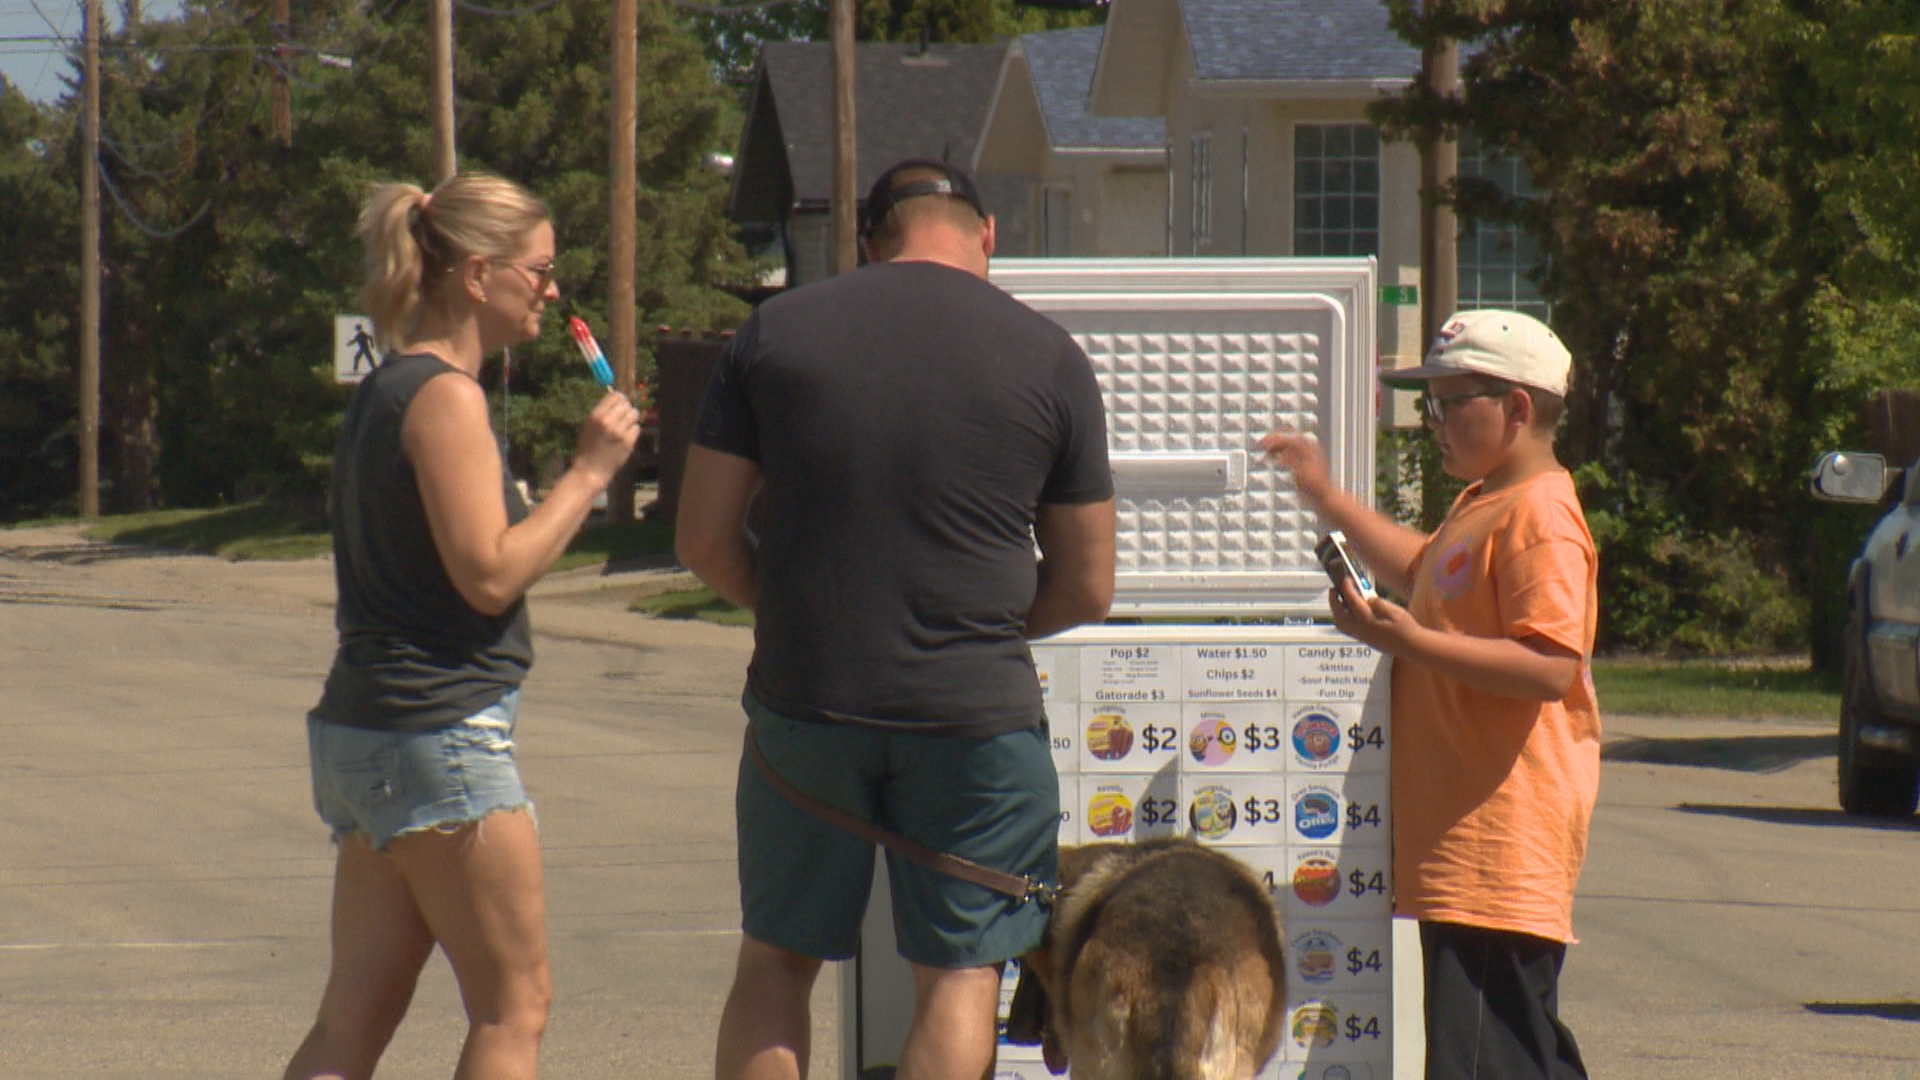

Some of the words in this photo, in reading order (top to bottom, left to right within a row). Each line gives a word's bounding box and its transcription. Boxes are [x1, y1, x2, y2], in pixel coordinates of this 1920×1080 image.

[1110, 647, 1132, 660] Pop
[1136, 647, 1150, 659] $2
[1197, 647, 1231, 659] Water
[1235, 647, 1267, 659] $1.50
[1298, 647, 1335, 660] Candy
[1340, 647, 1371, 659] $2.50
[1317, 663, 1354, 672] -Skittles
[1206, 669, 1238, 681] Chips
[1241, 669, 1255, 680] $2
[1325, 676, 1350, 685] Patch
[1095, 690, 1149, 700] Gatorade
[1151, 690, 1165, 701] $3
[1188, 689, 1234, 698] Sunflower
[1236, 689, 1264, 698] Seeds
[1266, 689, 1278, 699] $4
[1339, 689, 1355, 699] Dip
[1050, 737, 1071, 750] .50
[1142, 723, 1177, 754] $2
[1244, 723, 1280, 754] $3
[1347, 723, 1385, 753] $4
[1142, 797, 1177, 826] $2
[1244, 796, 1280, 827] $3
[1346, 801, 1382, 830] $4
[1349, 868, 1387, 898] $4
[1347, 946, 1383, 976] $4
[1345, 1012, 1382, 1042] $4
